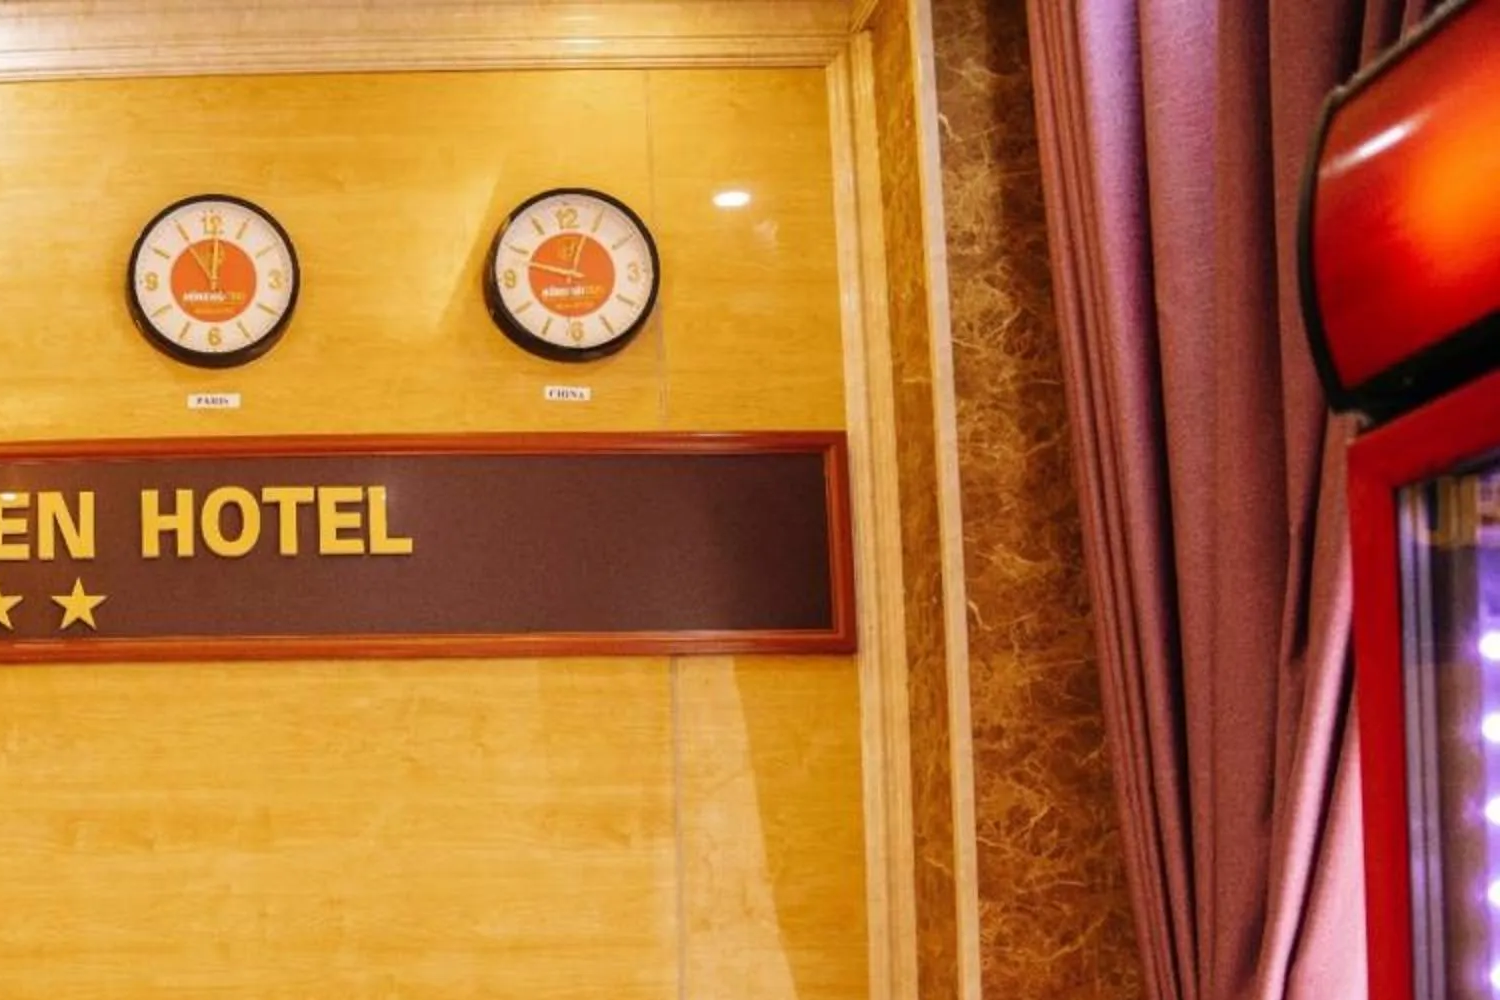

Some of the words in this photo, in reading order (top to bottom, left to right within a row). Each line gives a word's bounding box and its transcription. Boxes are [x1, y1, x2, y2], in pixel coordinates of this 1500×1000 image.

[556, 208, 579, 229] 12
[145, 272, 159, 291] 9
[267, 269, 282, 289] 3
[627, 262, 641, 282] 3
[208, 327, 222, 347] 6
[570, 321, 584, 341] 6
[141, 485, 415, 559] HOTEL
